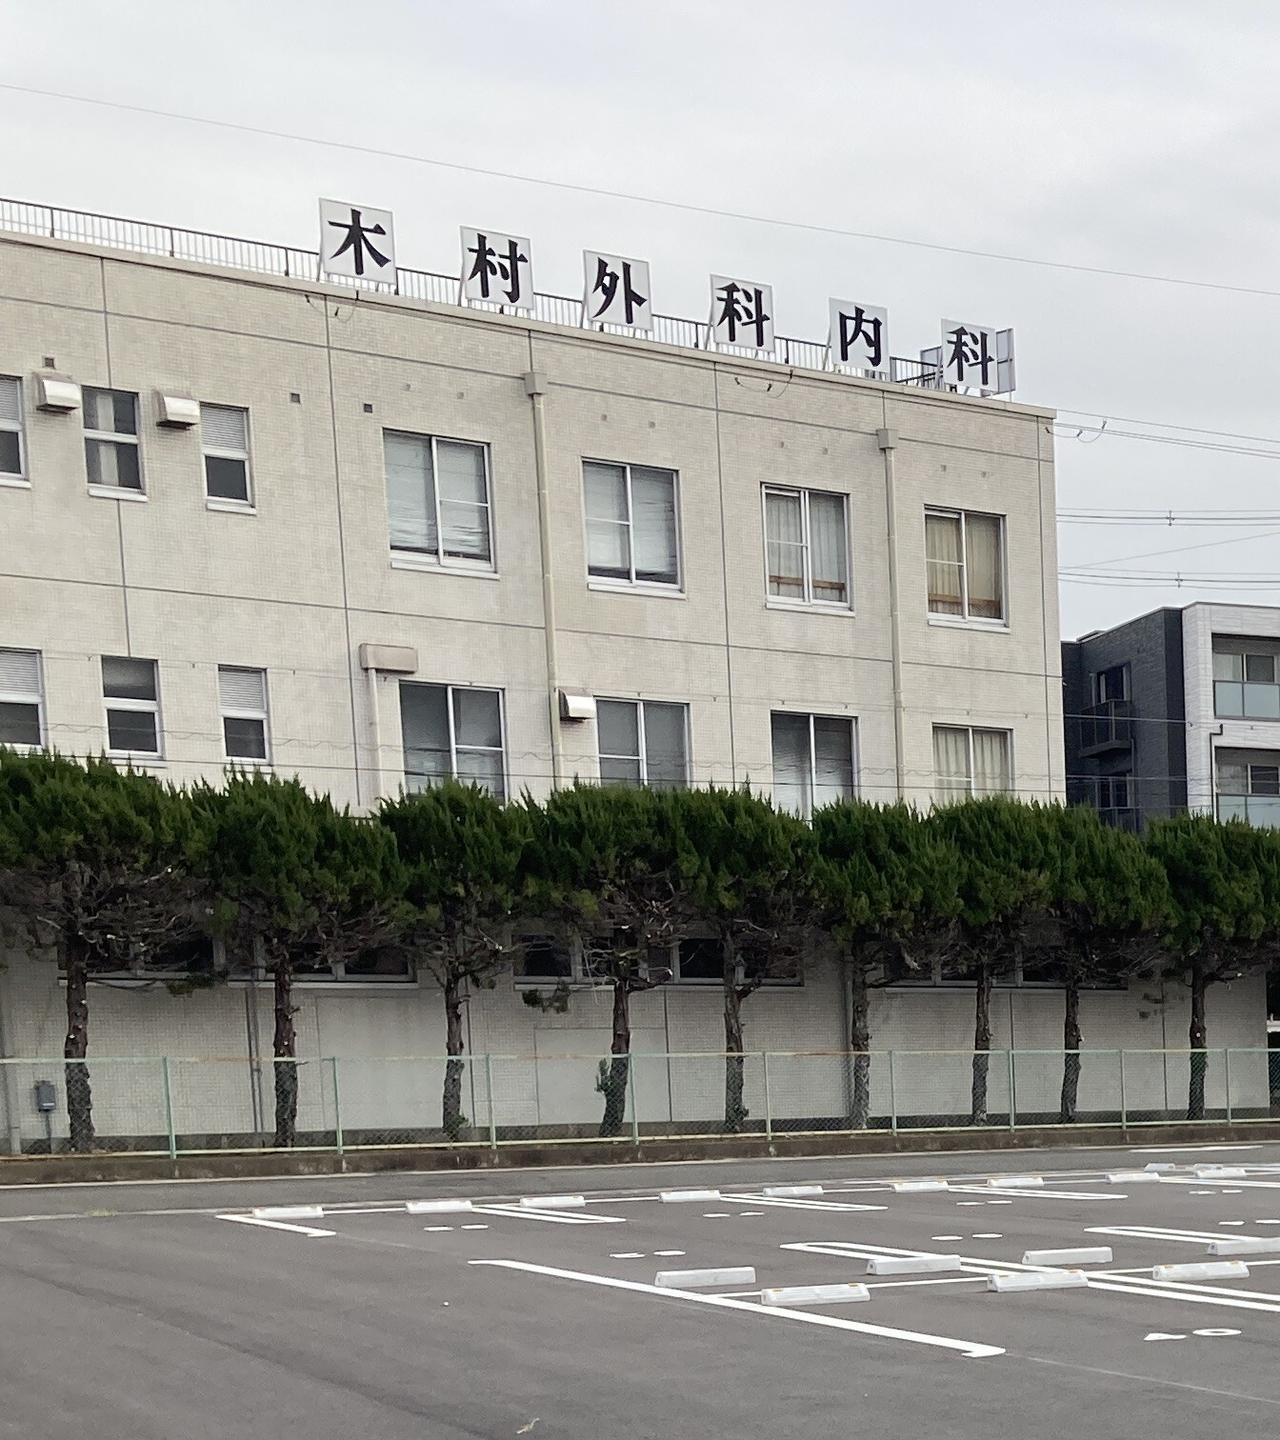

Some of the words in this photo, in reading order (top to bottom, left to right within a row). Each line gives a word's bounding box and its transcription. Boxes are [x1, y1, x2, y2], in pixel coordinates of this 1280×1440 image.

[328, 208, 995, 387] 木村外科内科
